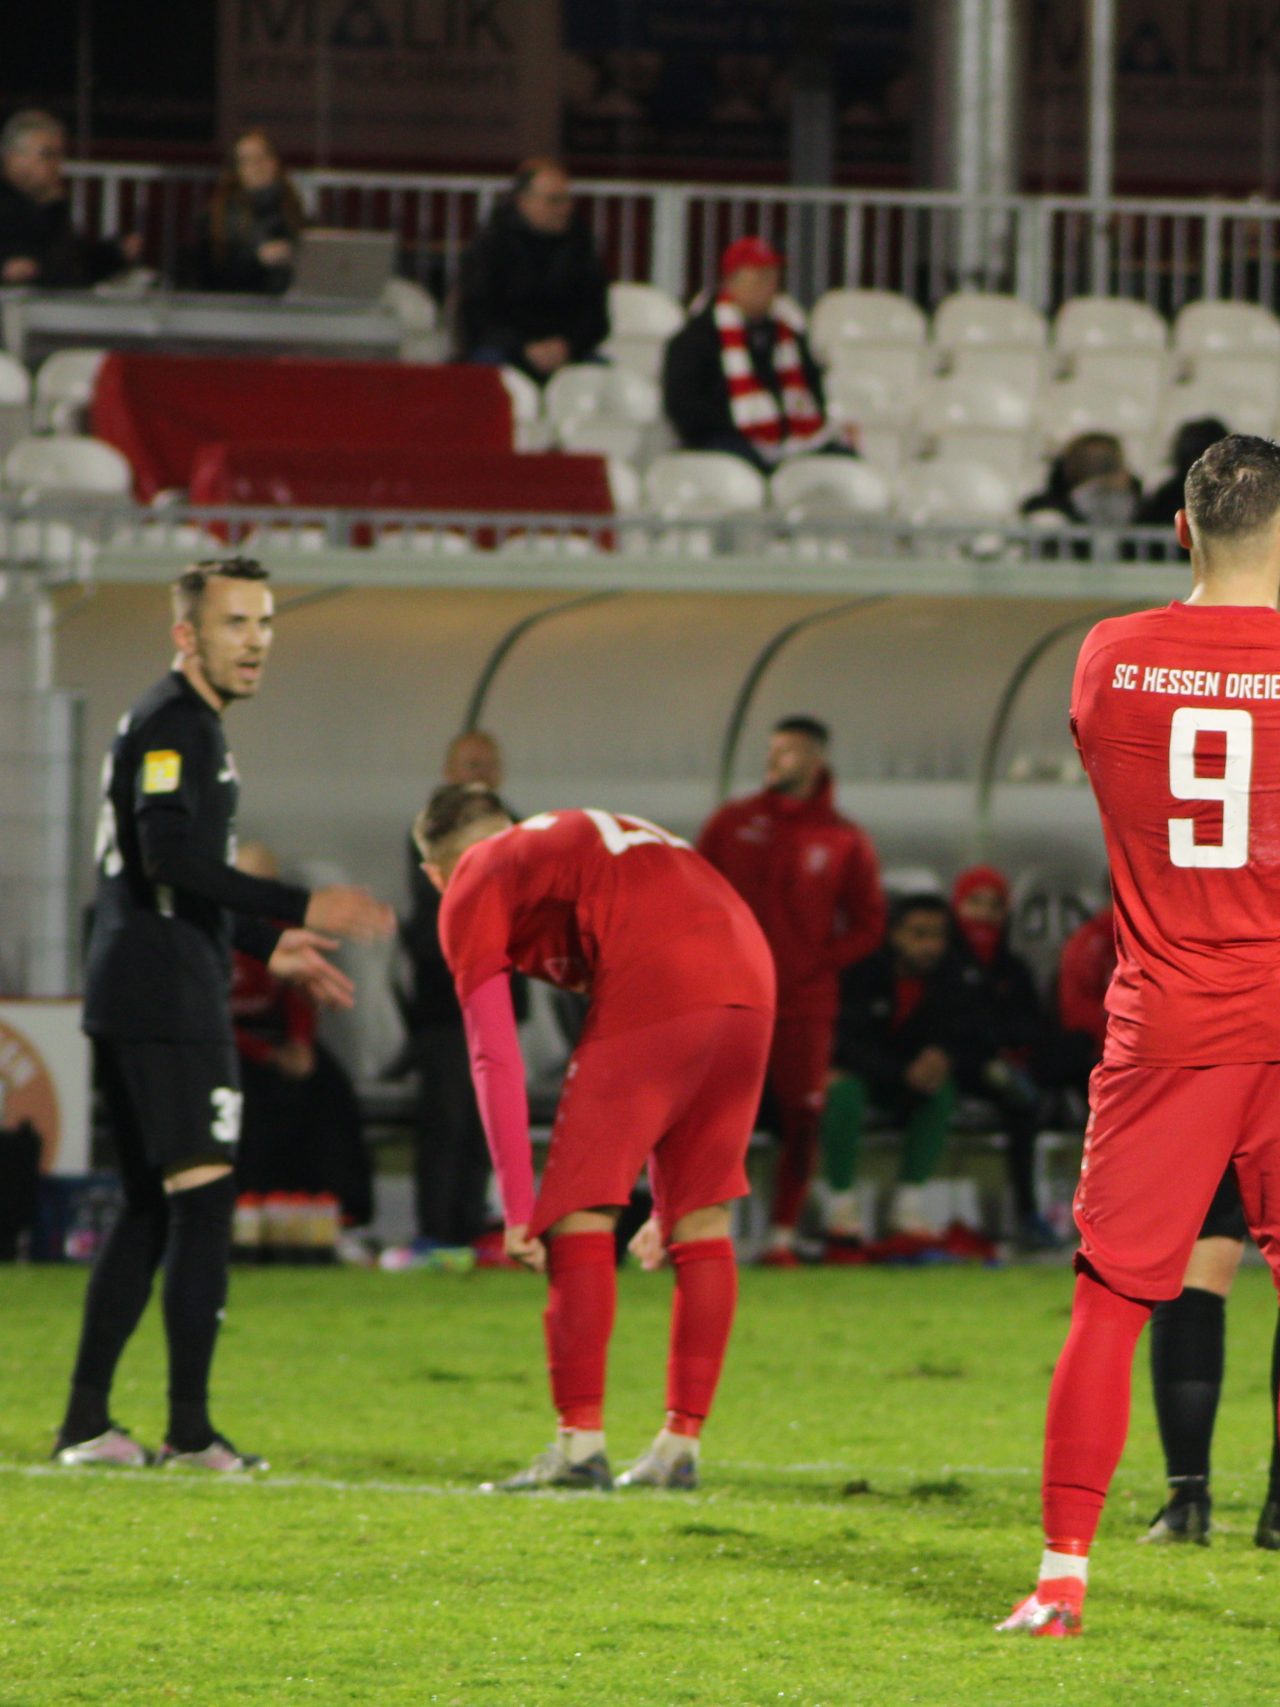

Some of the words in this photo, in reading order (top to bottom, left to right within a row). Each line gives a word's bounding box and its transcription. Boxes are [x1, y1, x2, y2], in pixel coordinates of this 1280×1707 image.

[1112, 663, 1137, 690] SC
[1142, 667, 1220, 697] HESSEN
[1168, 707, 1253, 868] 9
